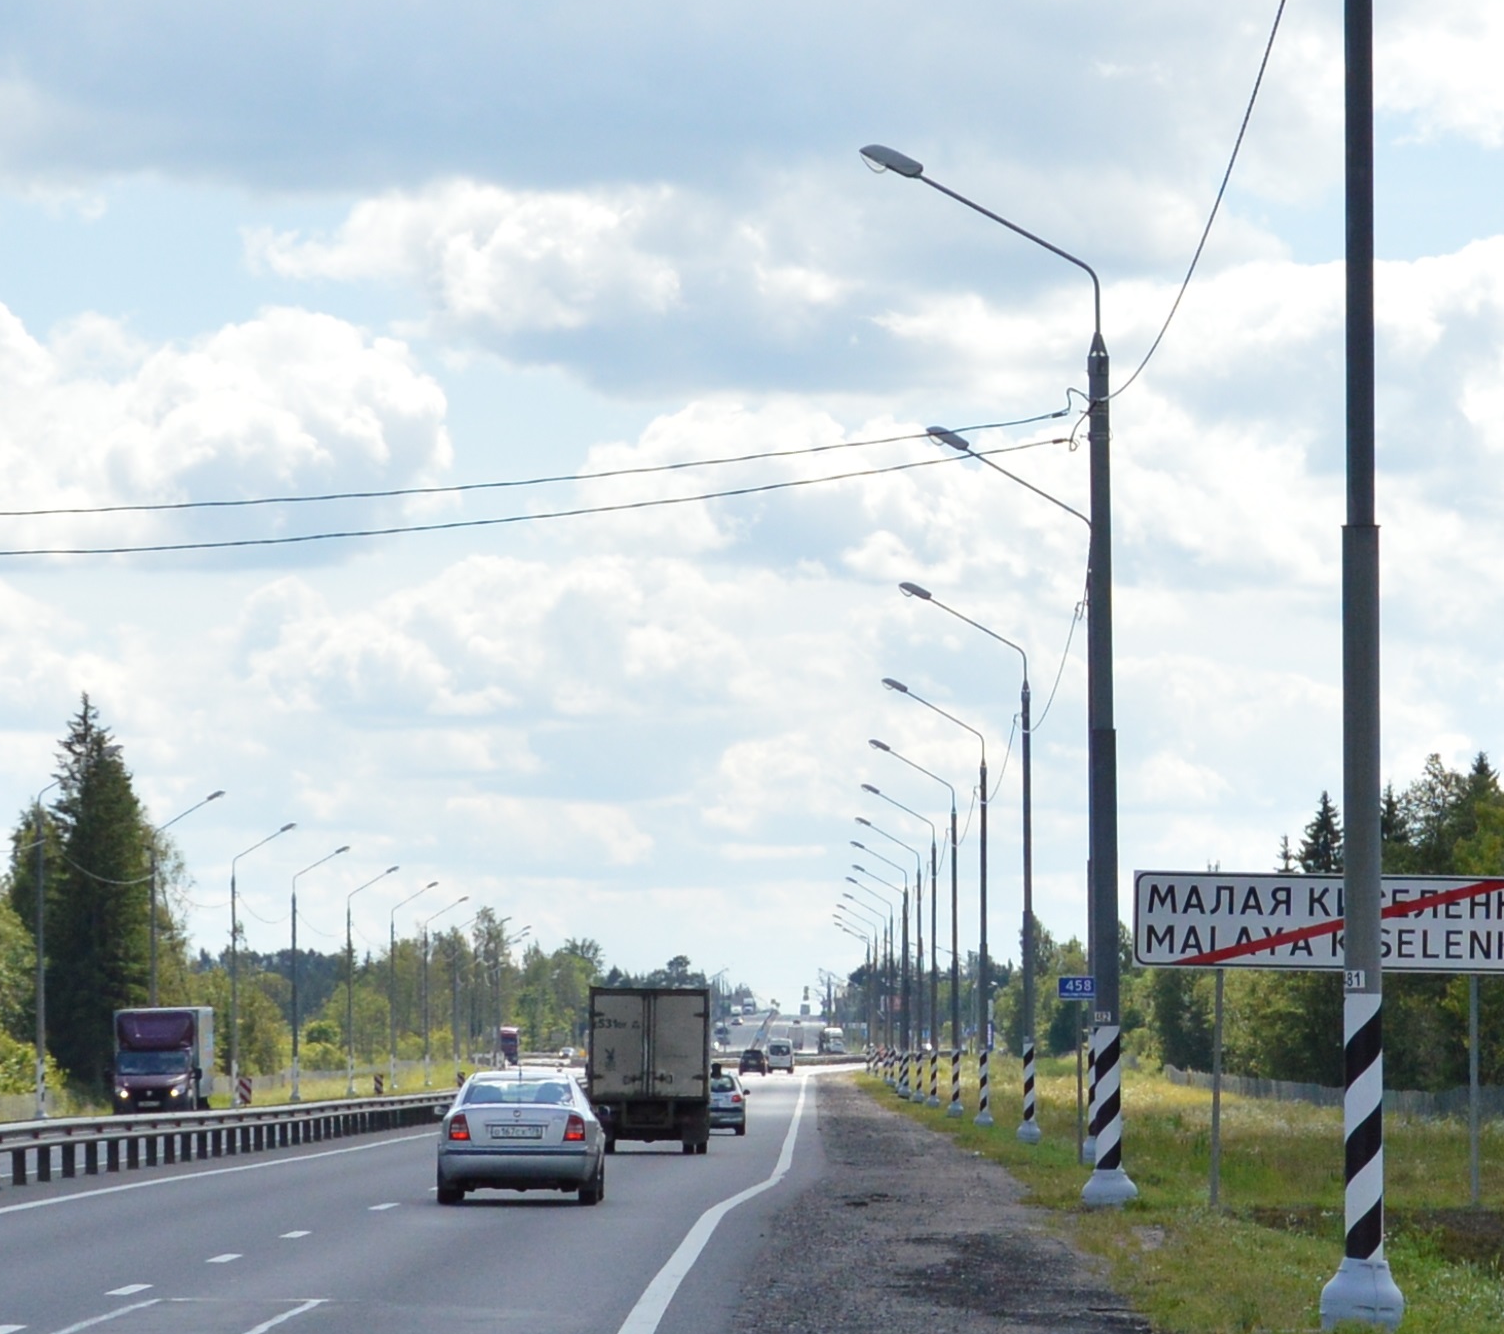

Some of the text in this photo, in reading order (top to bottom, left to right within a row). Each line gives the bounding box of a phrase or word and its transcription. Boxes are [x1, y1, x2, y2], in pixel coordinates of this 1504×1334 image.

[1147, 883, 1292, 917] МАЛАЯ
[1146, 924, 1313, 957] MALAYA
[1065, 979, 1092, 992] 458
